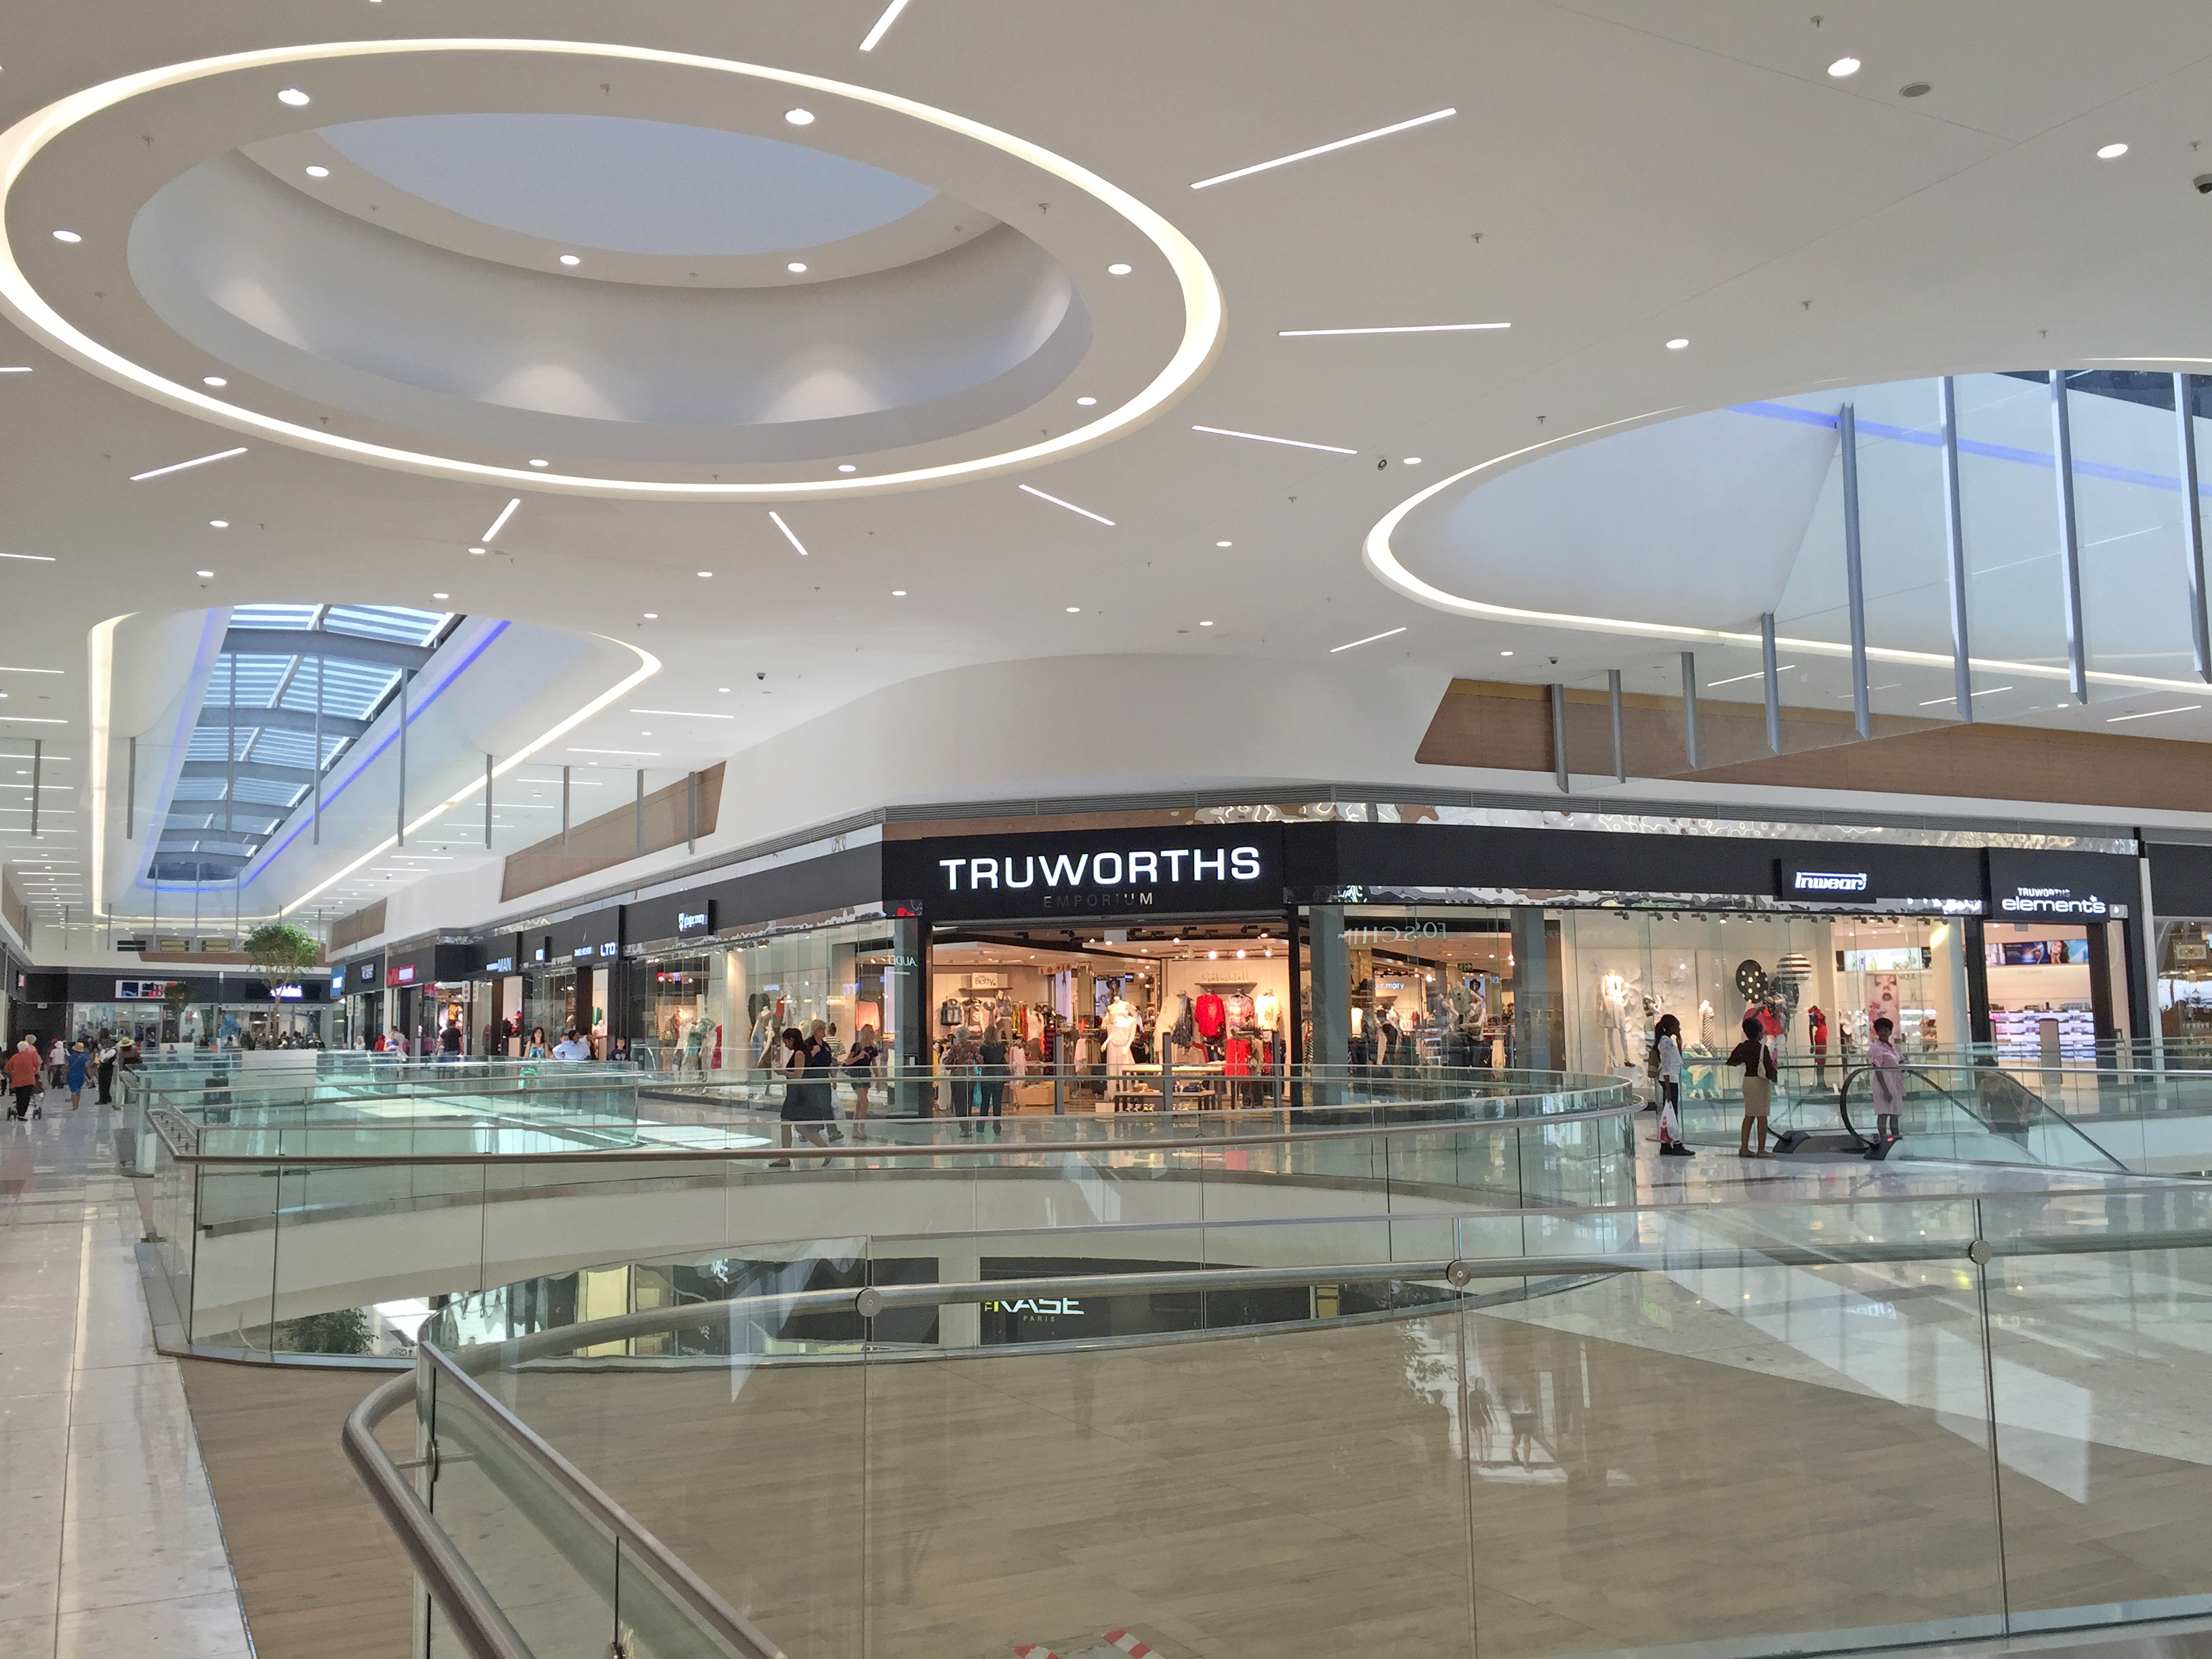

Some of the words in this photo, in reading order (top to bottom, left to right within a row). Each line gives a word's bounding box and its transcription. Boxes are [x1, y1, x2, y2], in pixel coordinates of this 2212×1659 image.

[939, 846, 1261, 890] TRUWORTHS
[2017, 887, 2071, 898] TRUWORTHS
[1043, 892, 1153, 909] EMPORIUM
[2001, 895, 2107, 914] elements
[600, 942, 616, 957] LTD
[497, 956, 513, 972] MAN
[1201, 968, 1249, 982] casual
[1023, 1315, 1056, 1323] PARIS
